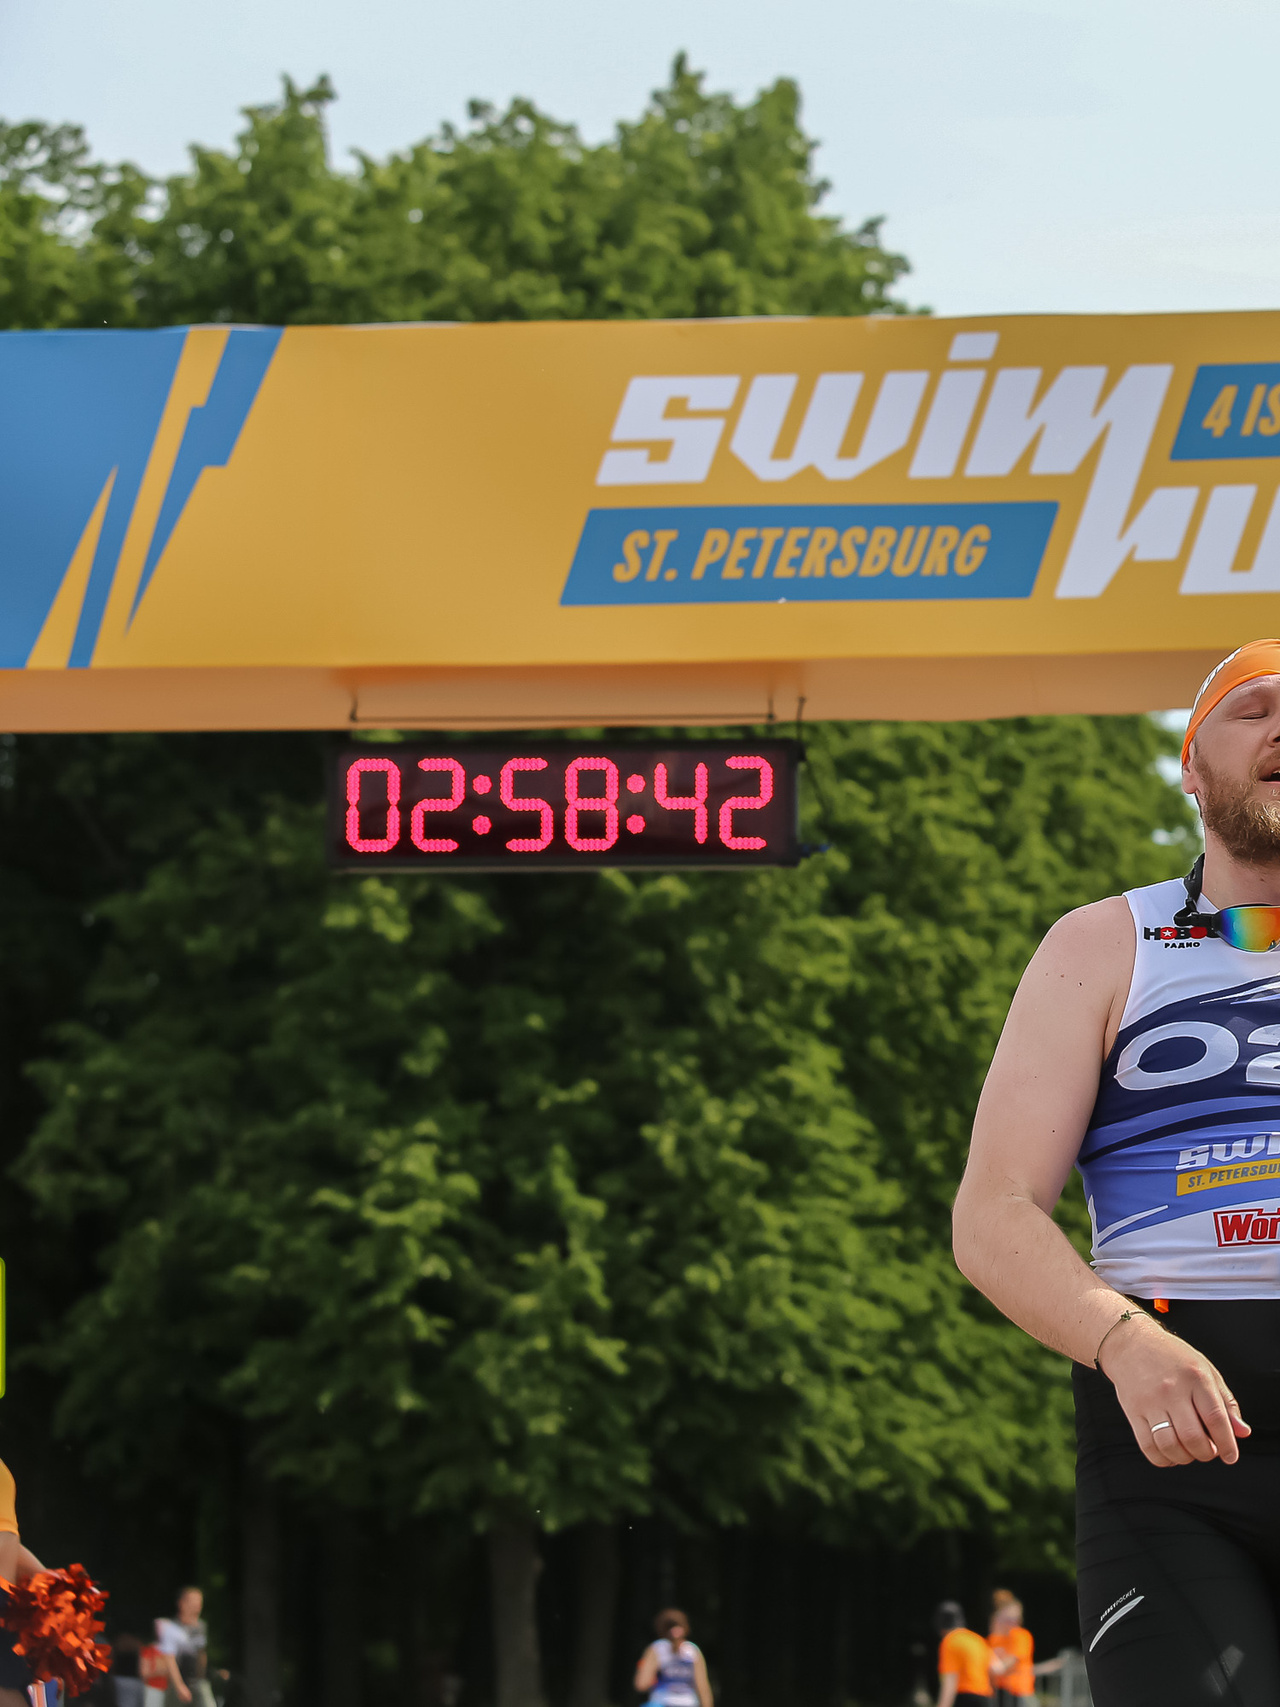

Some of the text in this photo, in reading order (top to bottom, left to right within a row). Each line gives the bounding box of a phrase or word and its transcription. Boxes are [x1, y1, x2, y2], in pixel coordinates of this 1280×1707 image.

[1202, 384, 1232, 436] 4
[612, 525, 991, 582] ST. PETERSBURG
[345, 755, 774, 853] 02:58:42
[1143, 926, 1221, 941] НОВО
[1164, 941, 1201, 949] РАДИО
[1187, 1174, 1205, 1189] ST.
